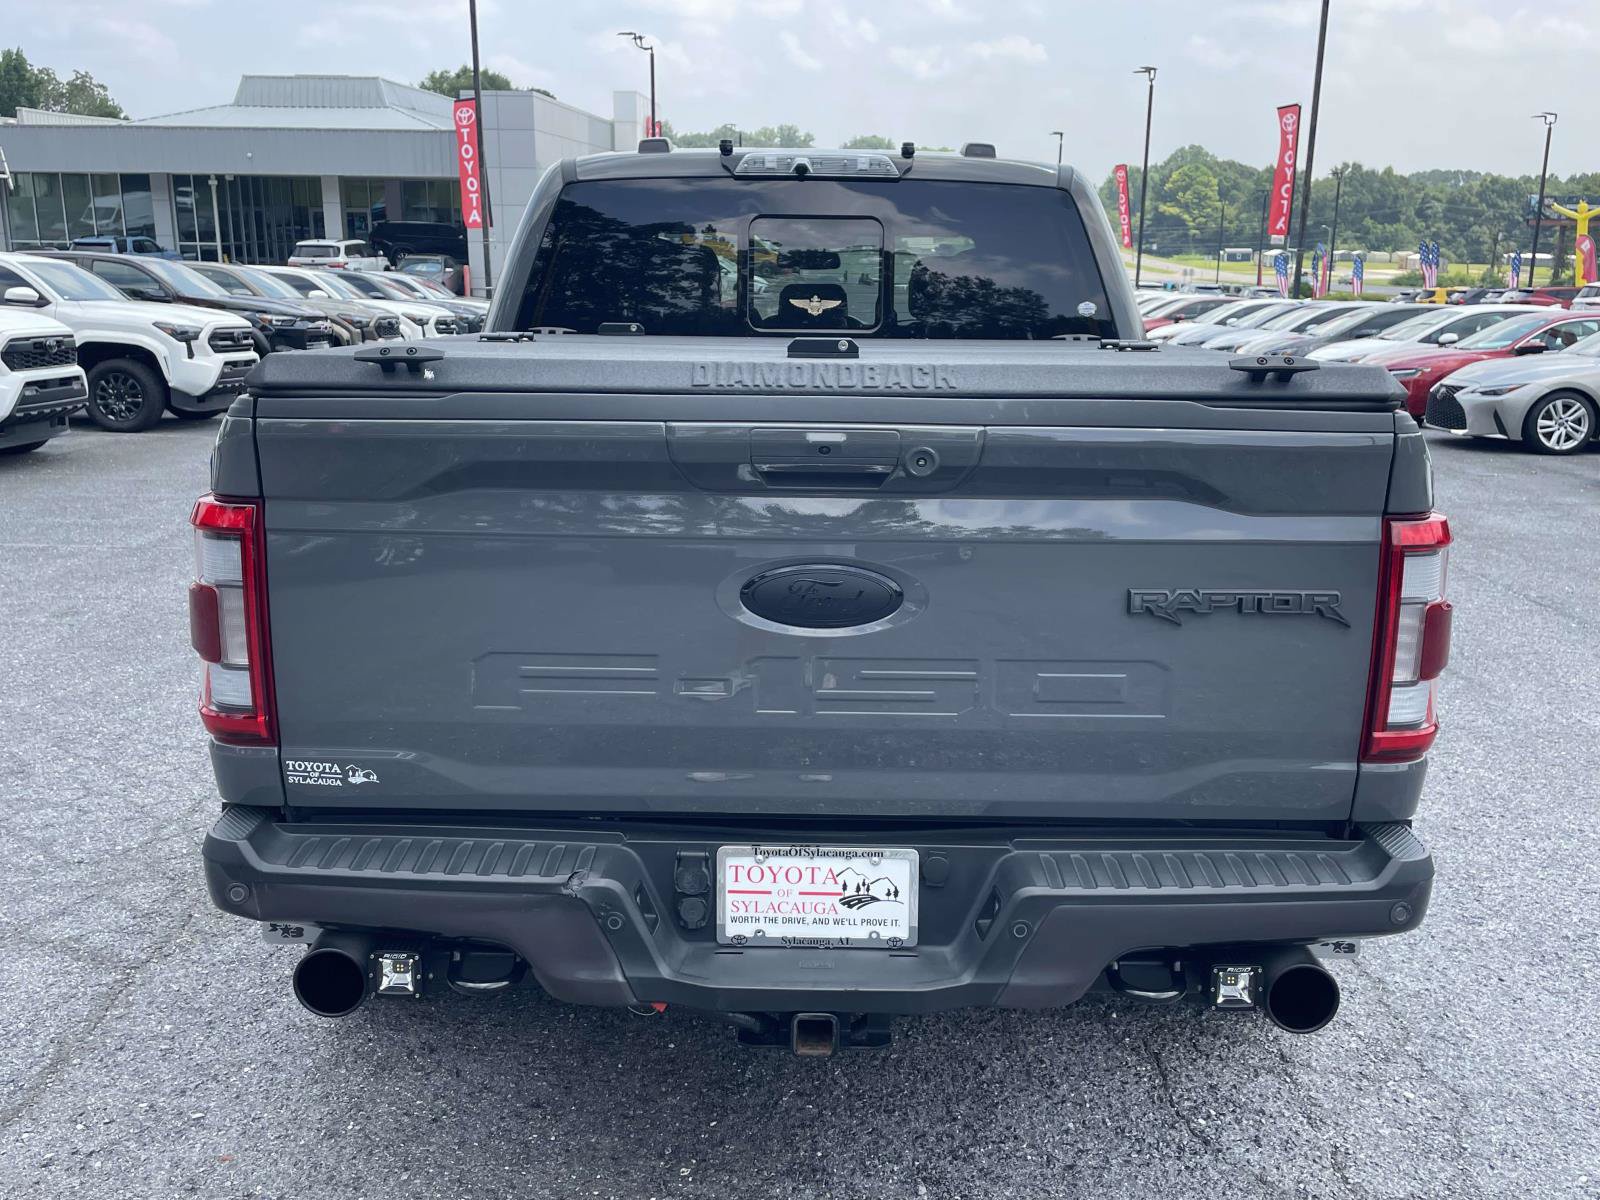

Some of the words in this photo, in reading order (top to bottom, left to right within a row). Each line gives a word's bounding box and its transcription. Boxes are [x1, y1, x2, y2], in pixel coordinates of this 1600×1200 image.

[461, 128, 481, 223] TOYOTA
[691, 363, 957, 389] DIAMONDBACK
[1127, 588, 1351, 628] RAPTOR
[286, 761, 341, 773] TOYOTA
[288, 776, 342, 786] SYLACAUGA
[752, 845, 884, 859] ToyotaOfSylacauga.com
[729, 864, 839, 885] TOYOTA
[777, 889, 792, 898] OF
[730, 900, 839, 915] SYLACAUGA
[730, 915, 760, 924] WORTH
[763, 916, 779, 924] THE
[781, 917, 809, 926] DRIVE,
[812, 917, 830, 926] AND
[833, 918, 858, 926] WE'LL
[861, 918, 888, 927] PROVE
[891, 918, 901, 927] IT.
[781, 936, 834, 948] Sylacauga,
